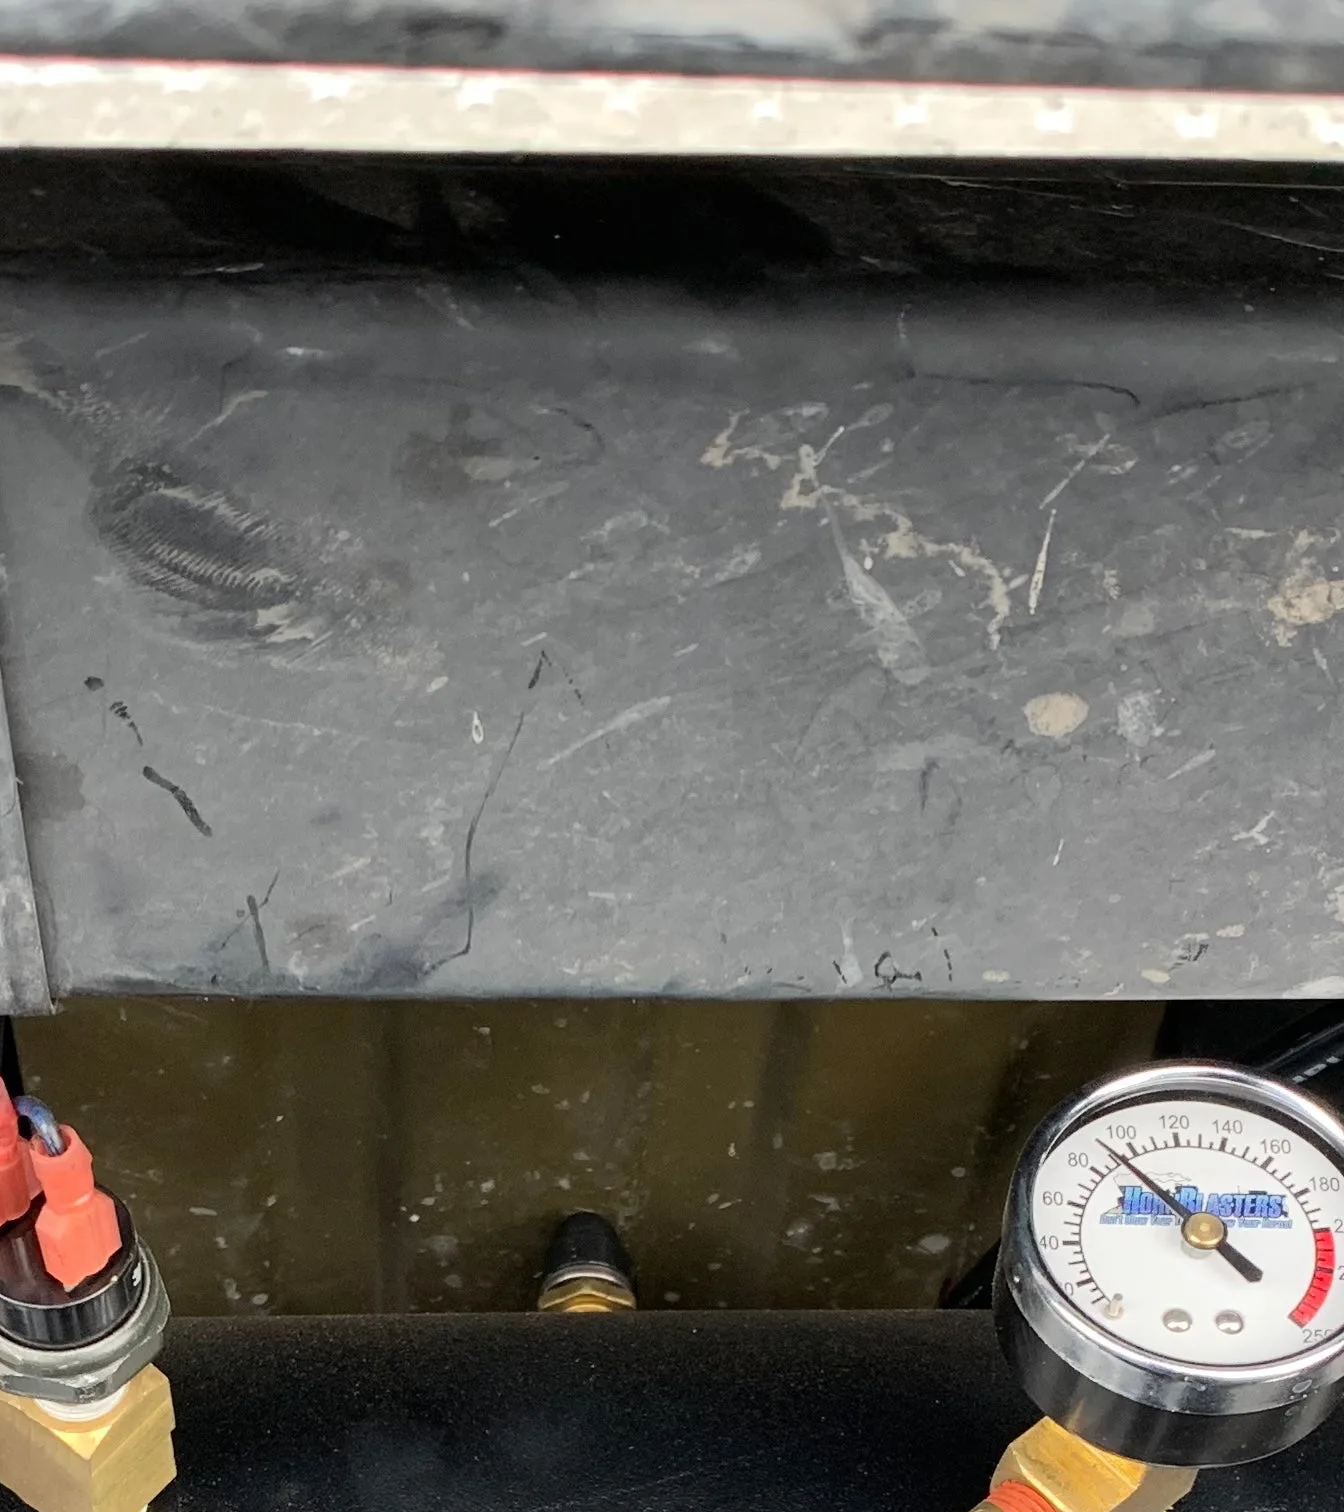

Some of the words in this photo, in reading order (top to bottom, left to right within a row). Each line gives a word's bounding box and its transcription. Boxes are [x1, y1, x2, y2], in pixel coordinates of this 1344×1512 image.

[1158, 1115, 1191, 1130] 120
[1212, 1119, 1244, 1135] 140
[1106, 1125, 1137, 1140] 100
[1260, 1138, 1292, 1155] 160
[1067, 1152, 1089, 1168] 80
[1310, 1176, 1340, 1193] 180
[1042, 1191, 1063, 1206] 60
[1039, 1235, 1059, 1250] 40
